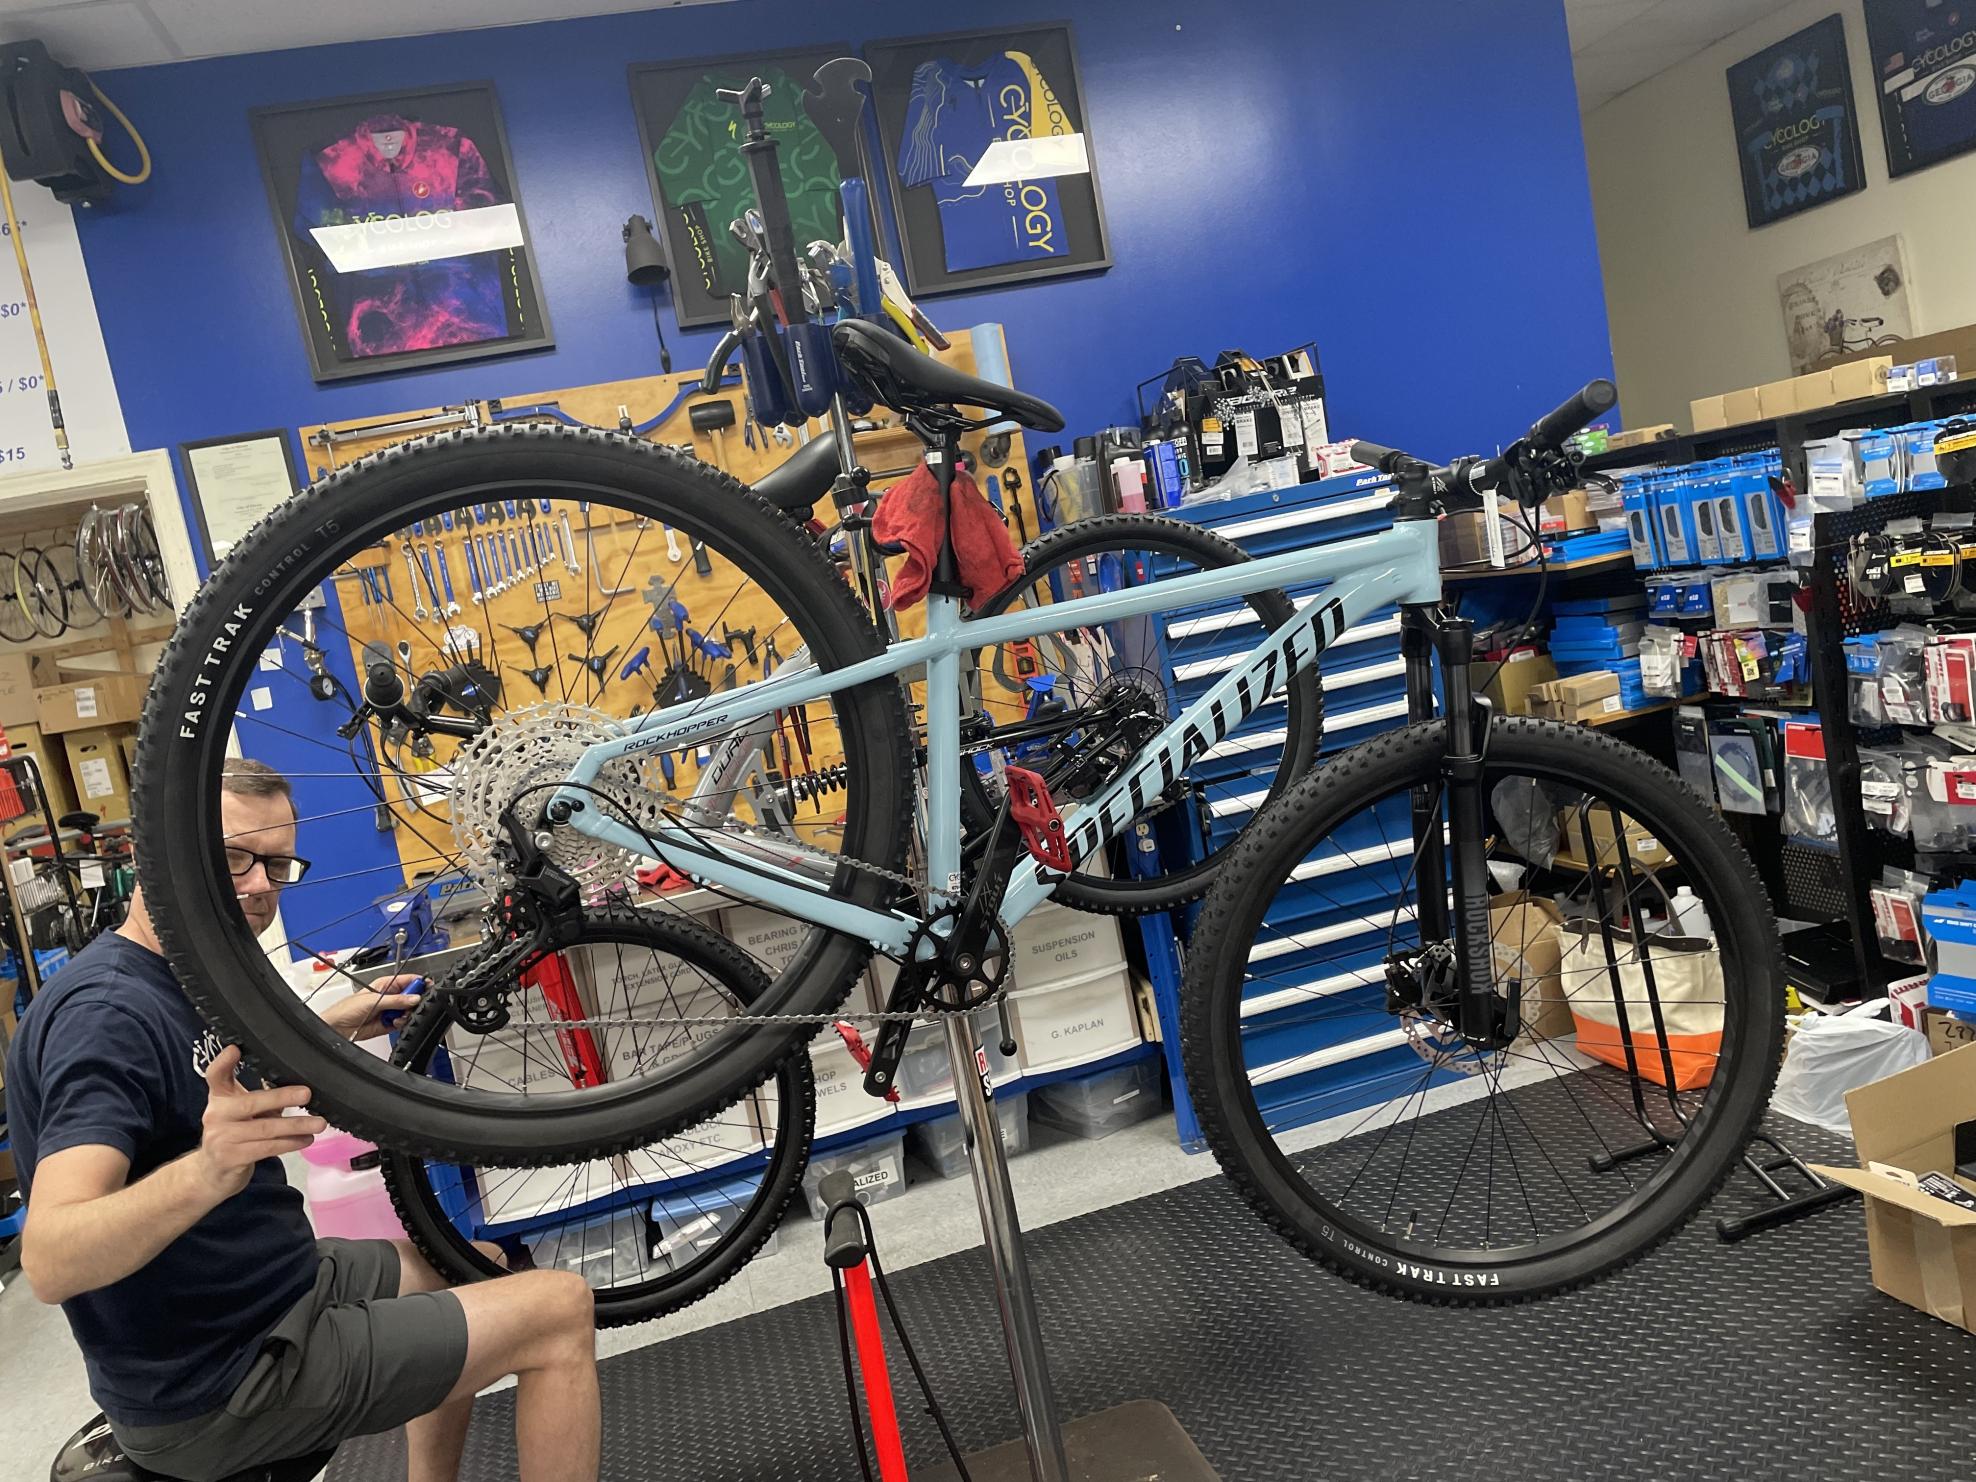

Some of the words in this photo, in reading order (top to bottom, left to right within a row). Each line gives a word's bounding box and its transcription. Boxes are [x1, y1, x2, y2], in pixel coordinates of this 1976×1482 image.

[254, 544, 311, 596] CONTROL
[315, 519, 341, 540] T5
[179, 673, 213, 739] FAST
[204, 602, 253, 666] TRAK
[623, 713, 729, 752] ROCKHOPPER
[748, 926, 798, 946] BEARING
[1031, 930, 1095, 955] SUSPENSION
[765, 940, 799, 956] CHRIS
[1055, 949, 1079, 962] OILS
[1051, 1030, 1063, 1039] G.
[1064, 1018, 1105, 1036] KAPLAN
[508, 1069, 556, 1087] CABLES
[1321, 1224, 1336, 1243] T5
[1342, 1239, 1388, 1267] CONTROL
[1396, 1261, 1447, 1285] TRAK
[1452, 1272, 1500, 1287] FAST
